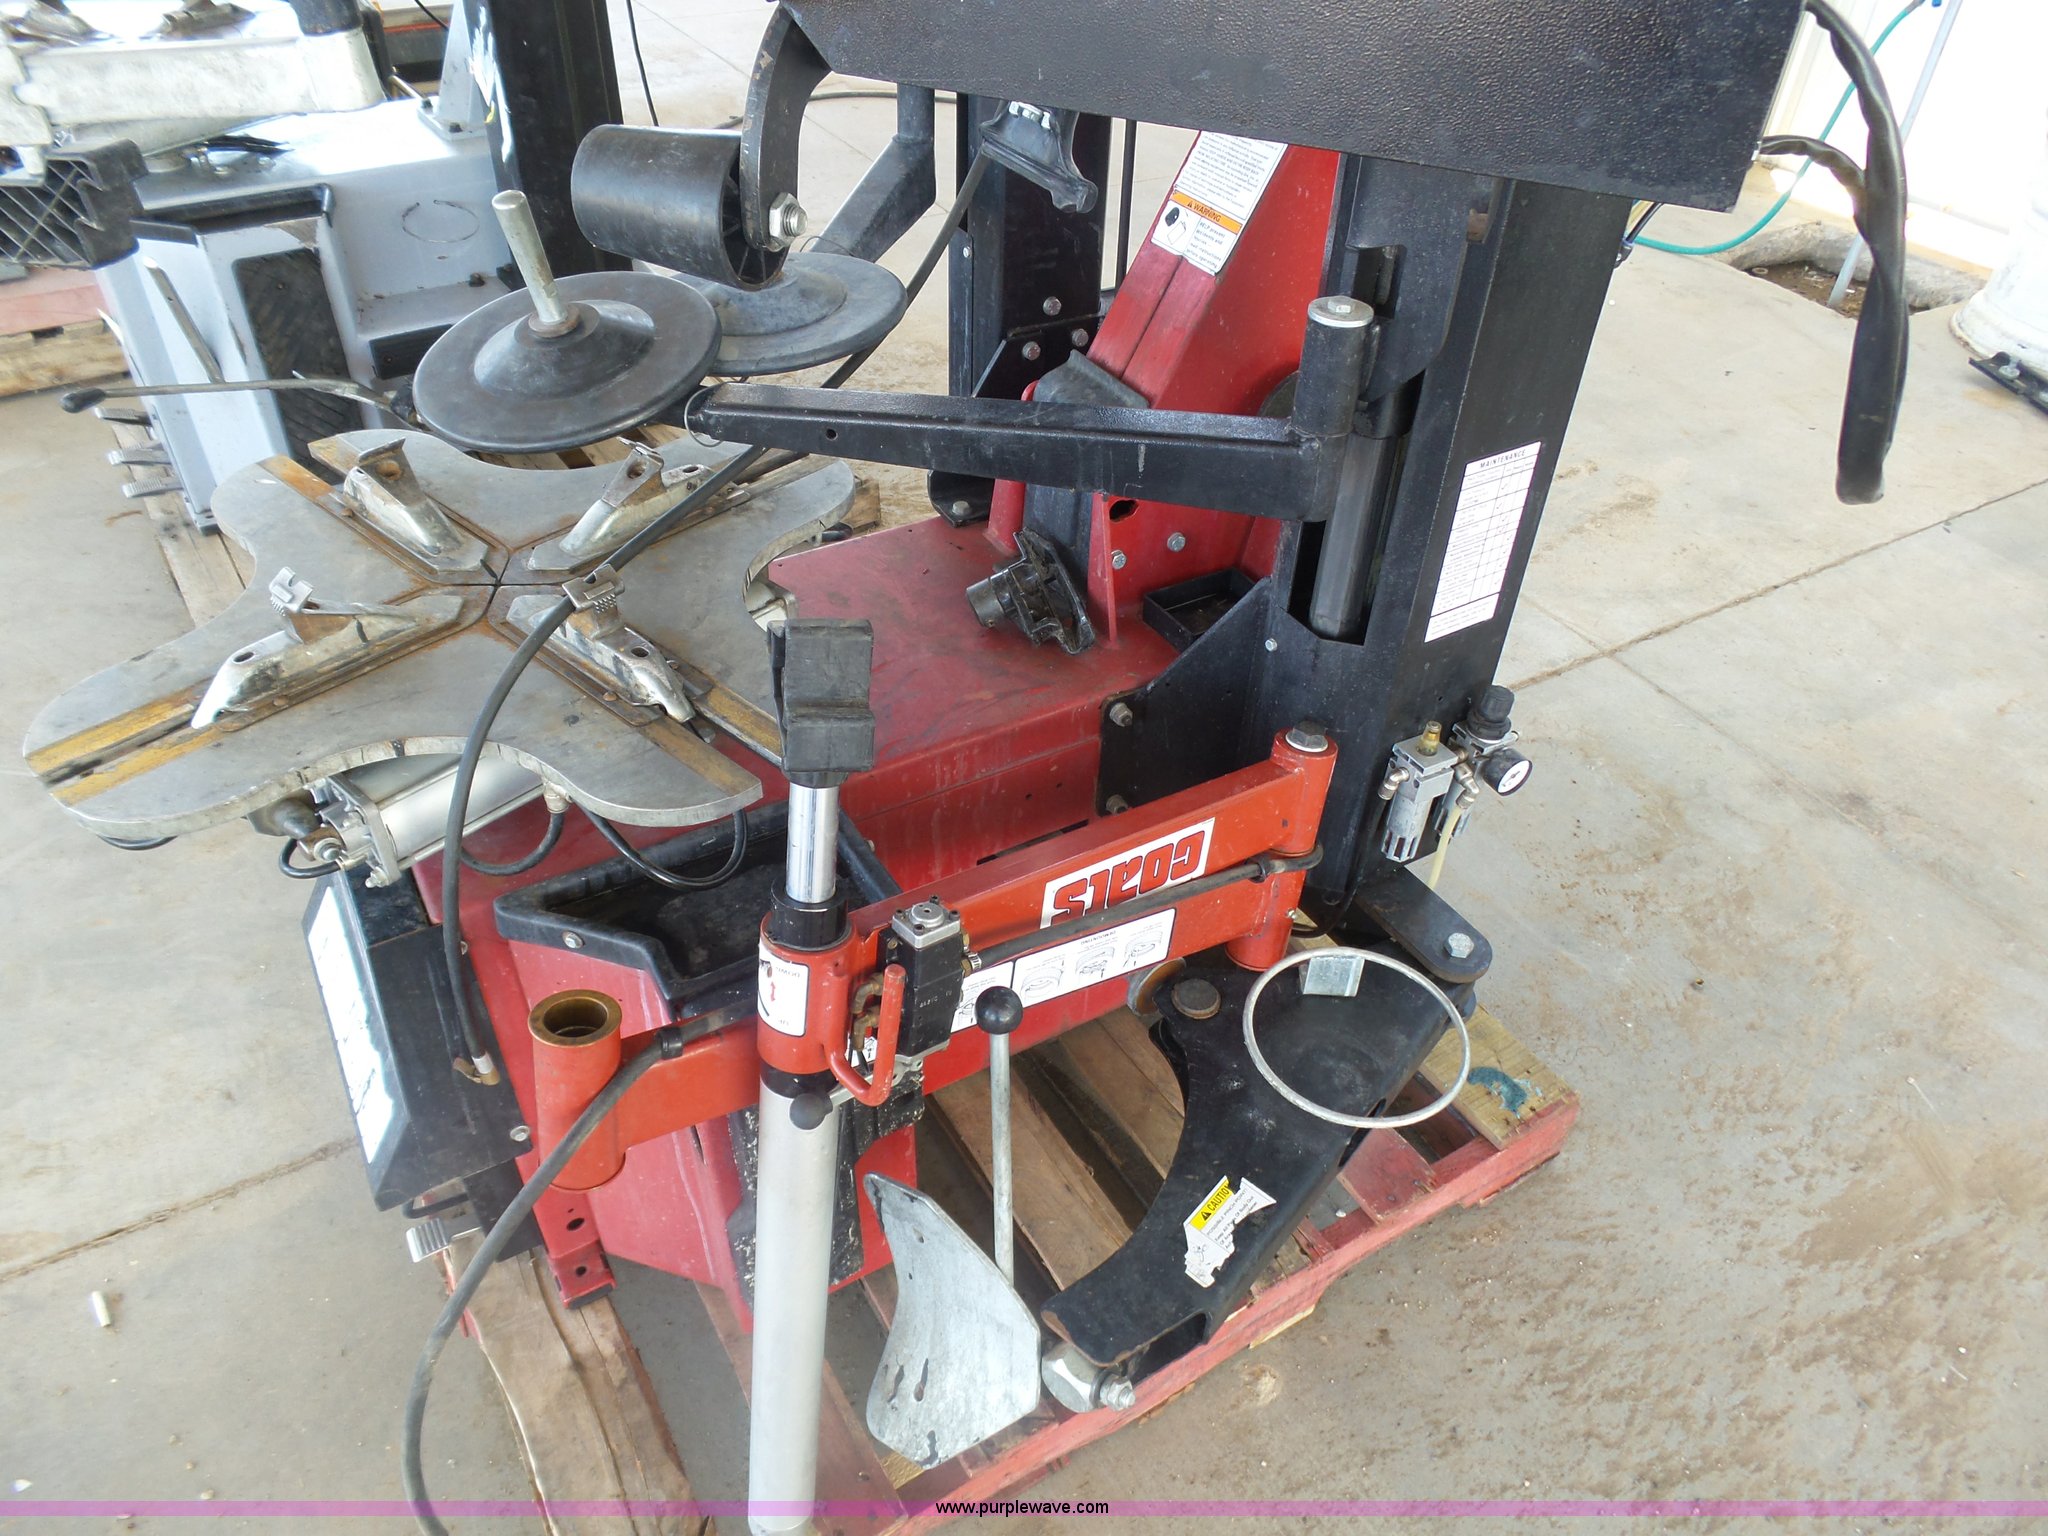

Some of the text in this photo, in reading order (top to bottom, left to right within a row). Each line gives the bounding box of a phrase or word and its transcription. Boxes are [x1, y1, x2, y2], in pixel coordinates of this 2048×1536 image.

[1193, 202, 1222, 222] WARNING
[1480, 449, 1527, 468] MAINTENANCE
[1206, 1184, 1230, 1211] CAUTIO
